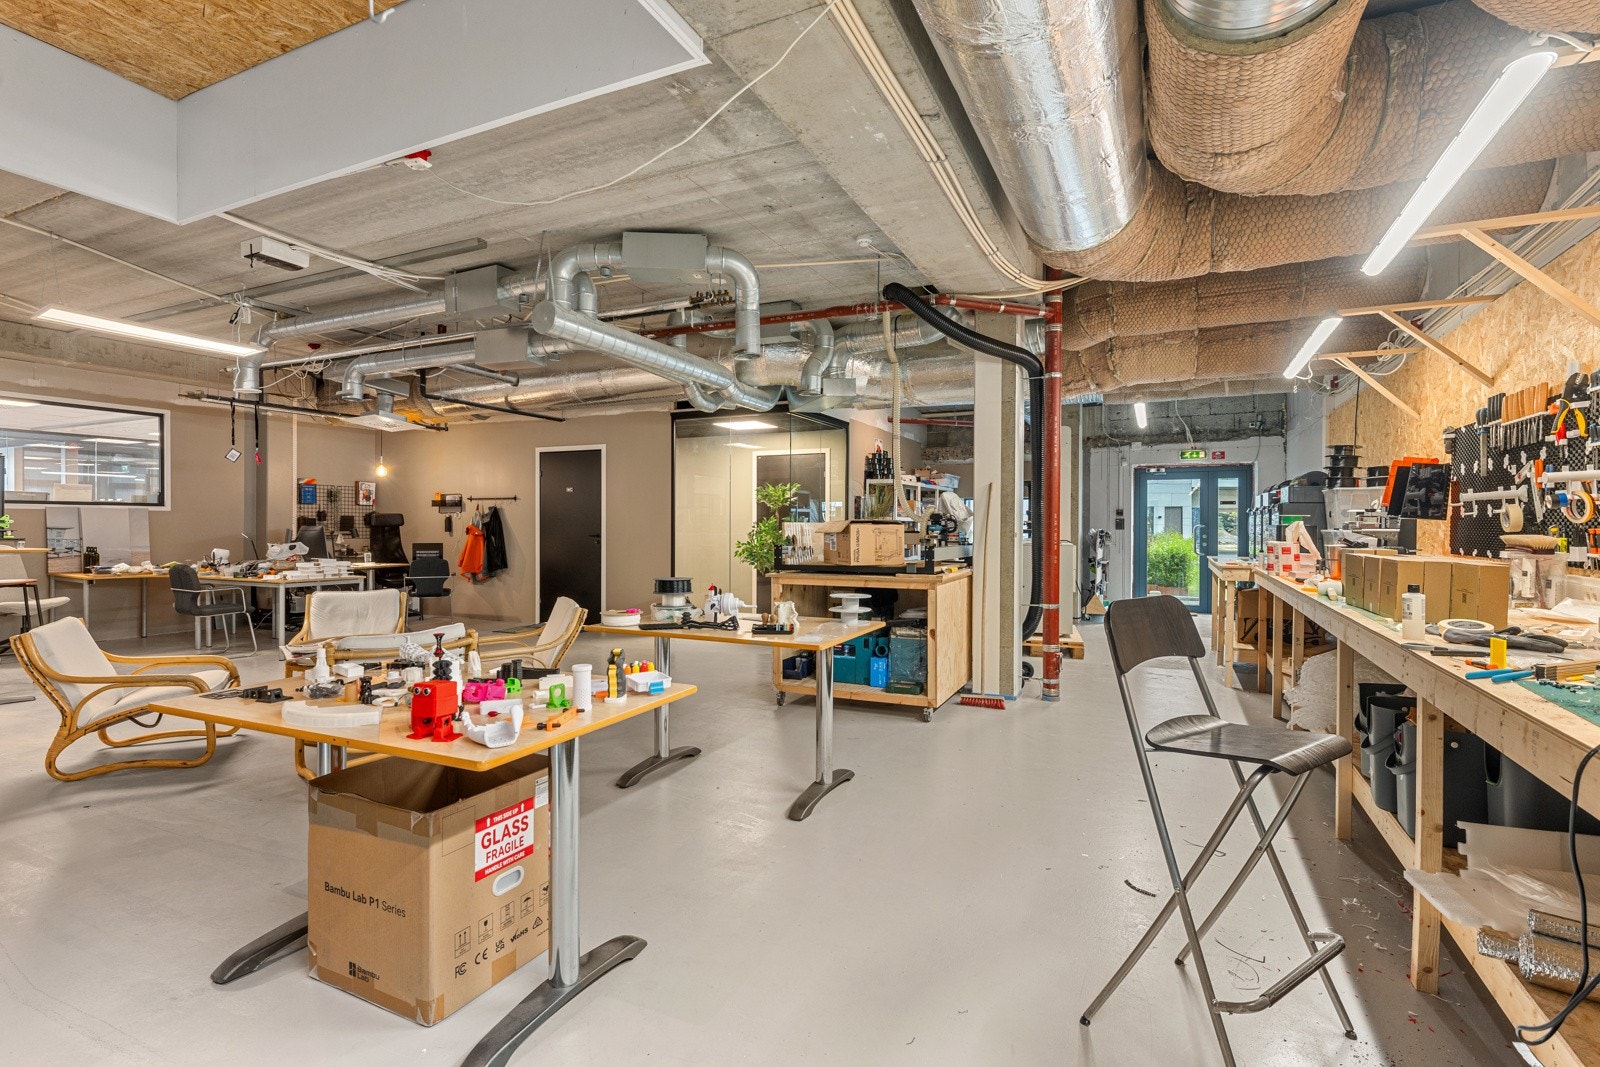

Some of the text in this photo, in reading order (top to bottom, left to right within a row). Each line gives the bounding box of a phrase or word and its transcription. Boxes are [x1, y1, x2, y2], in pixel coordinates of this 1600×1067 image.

[481, 815, 529, 849] GLASS
[484, 861, 503, 875] HANDLE
[514, 850, 525, 860] CARE
[485, 836, 525, 863] FRAGILE
[324, 881, 406, 918] Bambu Lab P1 Series
[357, 964, 380, 980] Bambu
[357, 973, 370, 982] Lab
